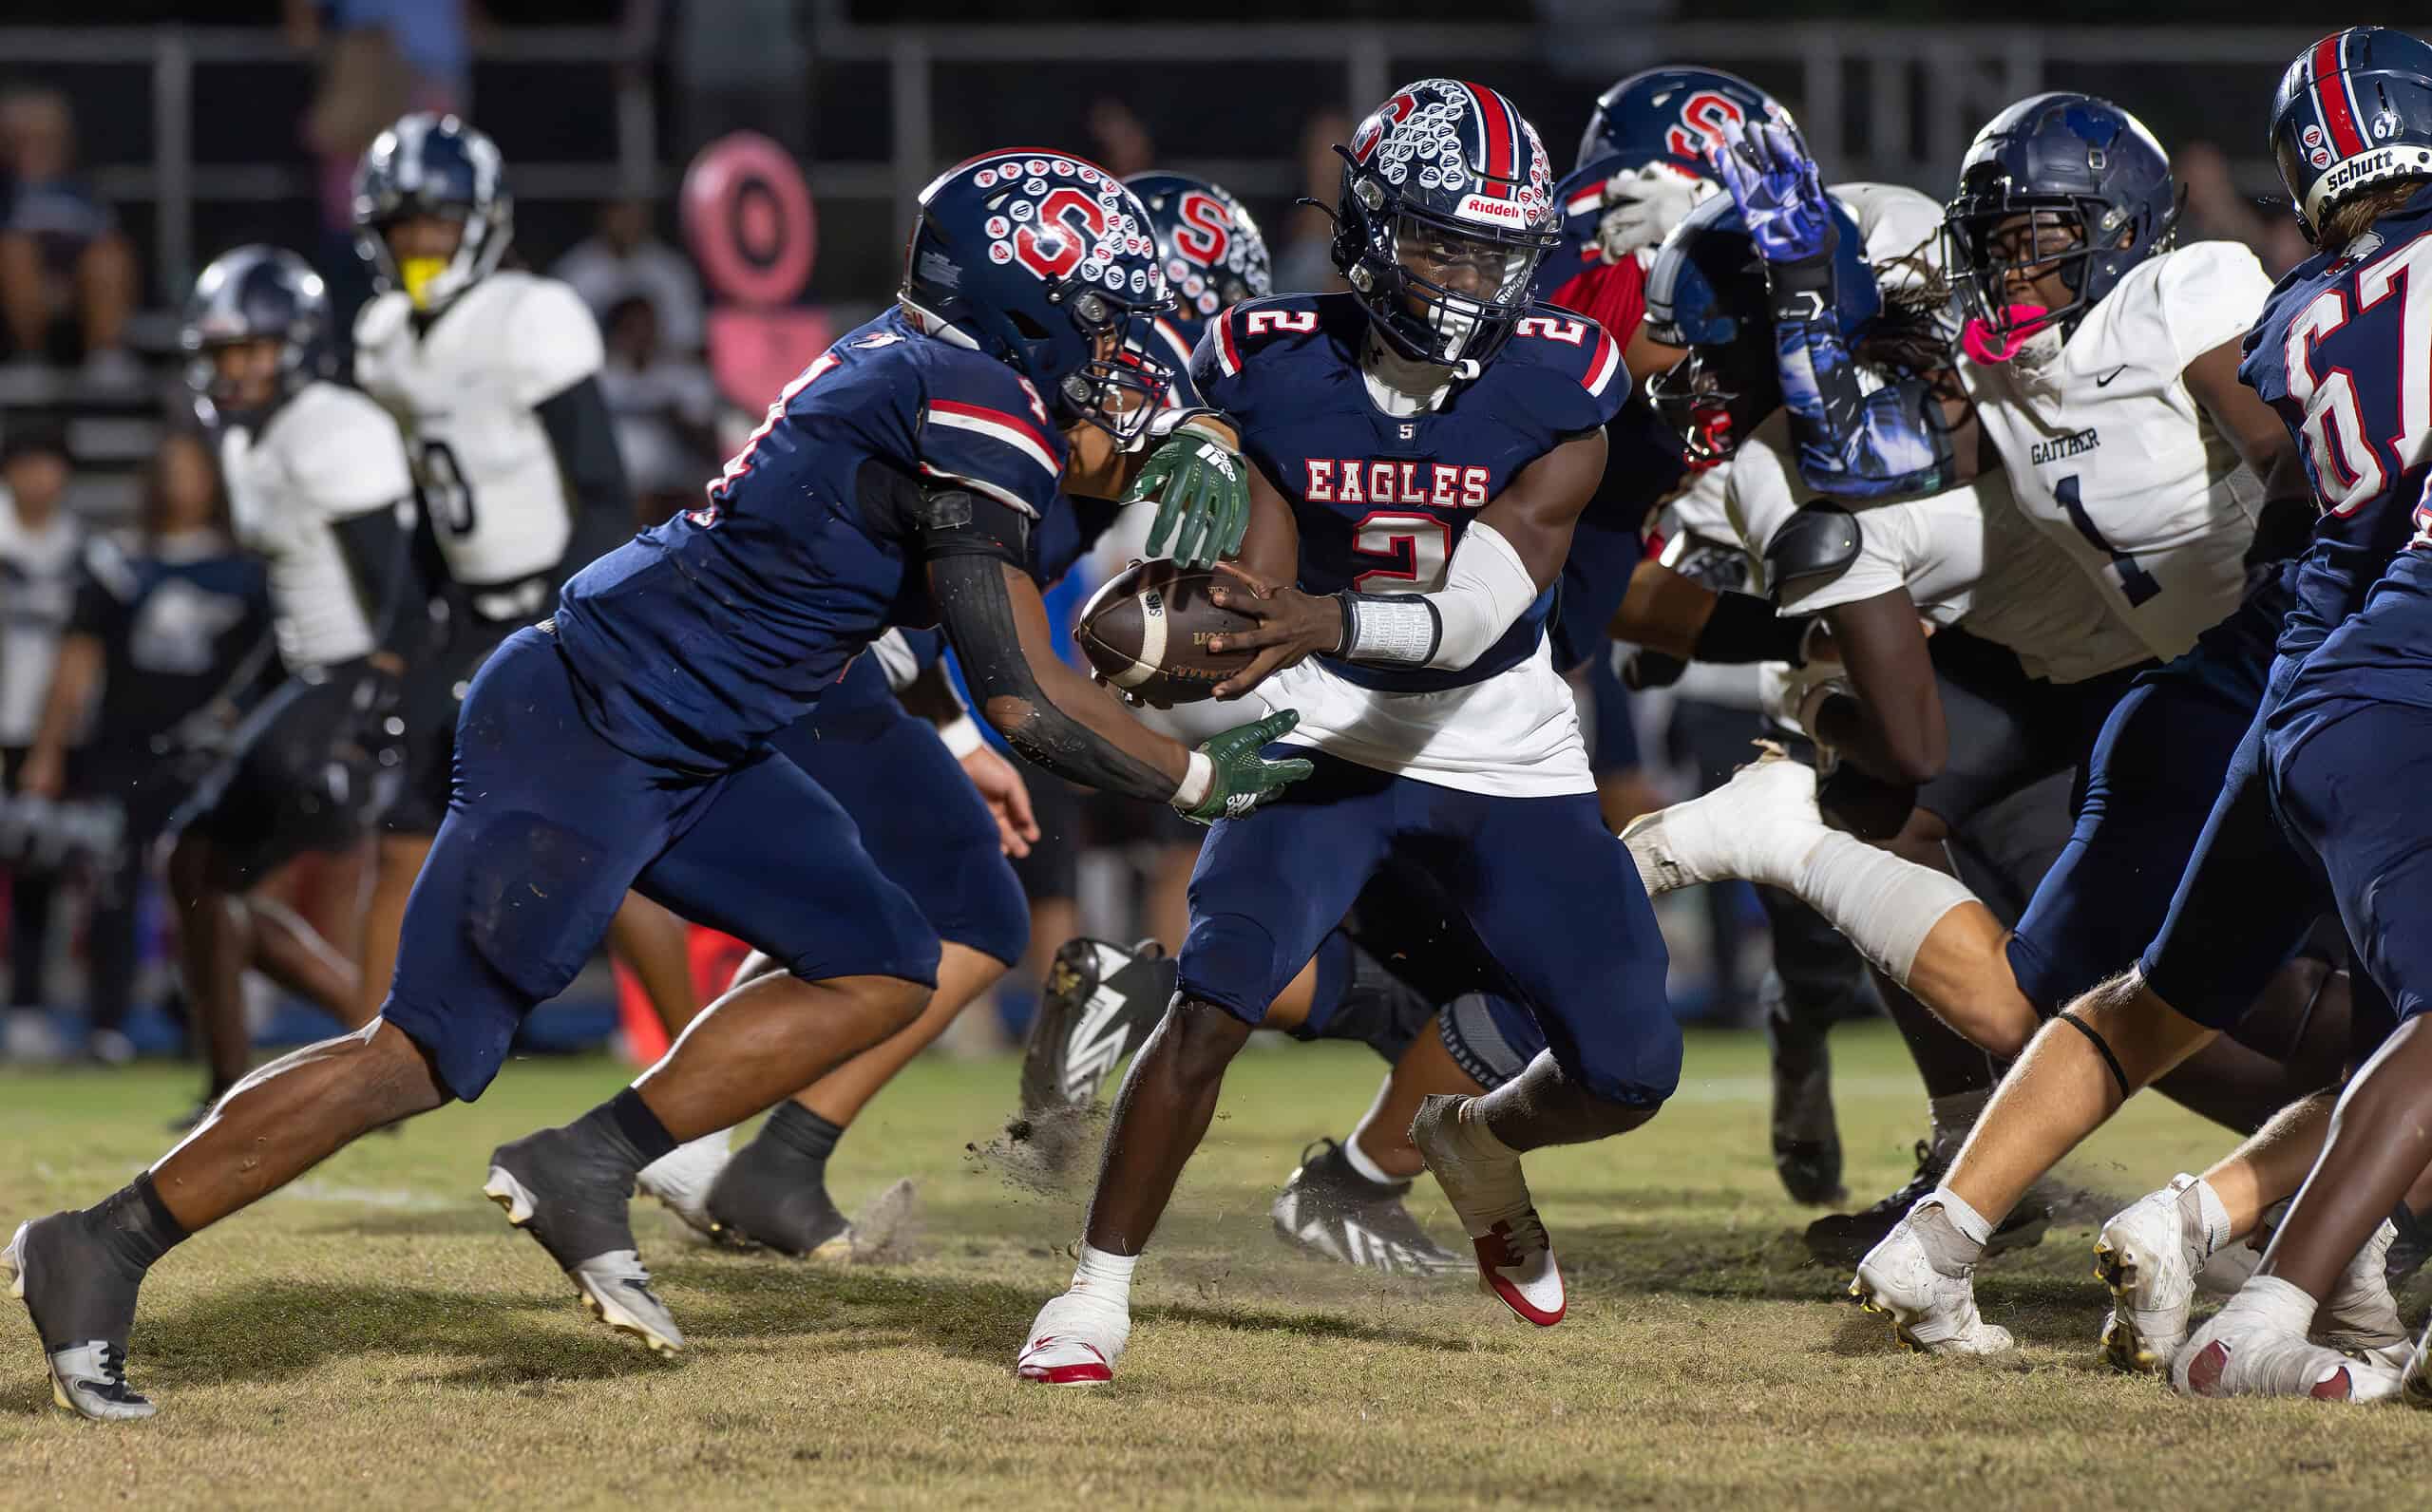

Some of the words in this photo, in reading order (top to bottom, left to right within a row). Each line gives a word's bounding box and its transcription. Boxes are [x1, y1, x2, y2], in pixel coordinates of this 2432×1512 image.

[1013, 186, 1109, 282] S
[1172, 190, 1236, 269] S
[1245, 310, 1320, 336] 2
[1516, 315, 1586, 348] 2
[2285, 231, 2432, 519] 67
[1304, 457, 1491, 509] EAGLES
[2030, 426, 2101, 465] GAITHER
[1352, 510, 1452, 595] 2
[2053, 473, 2162, 609] 1
